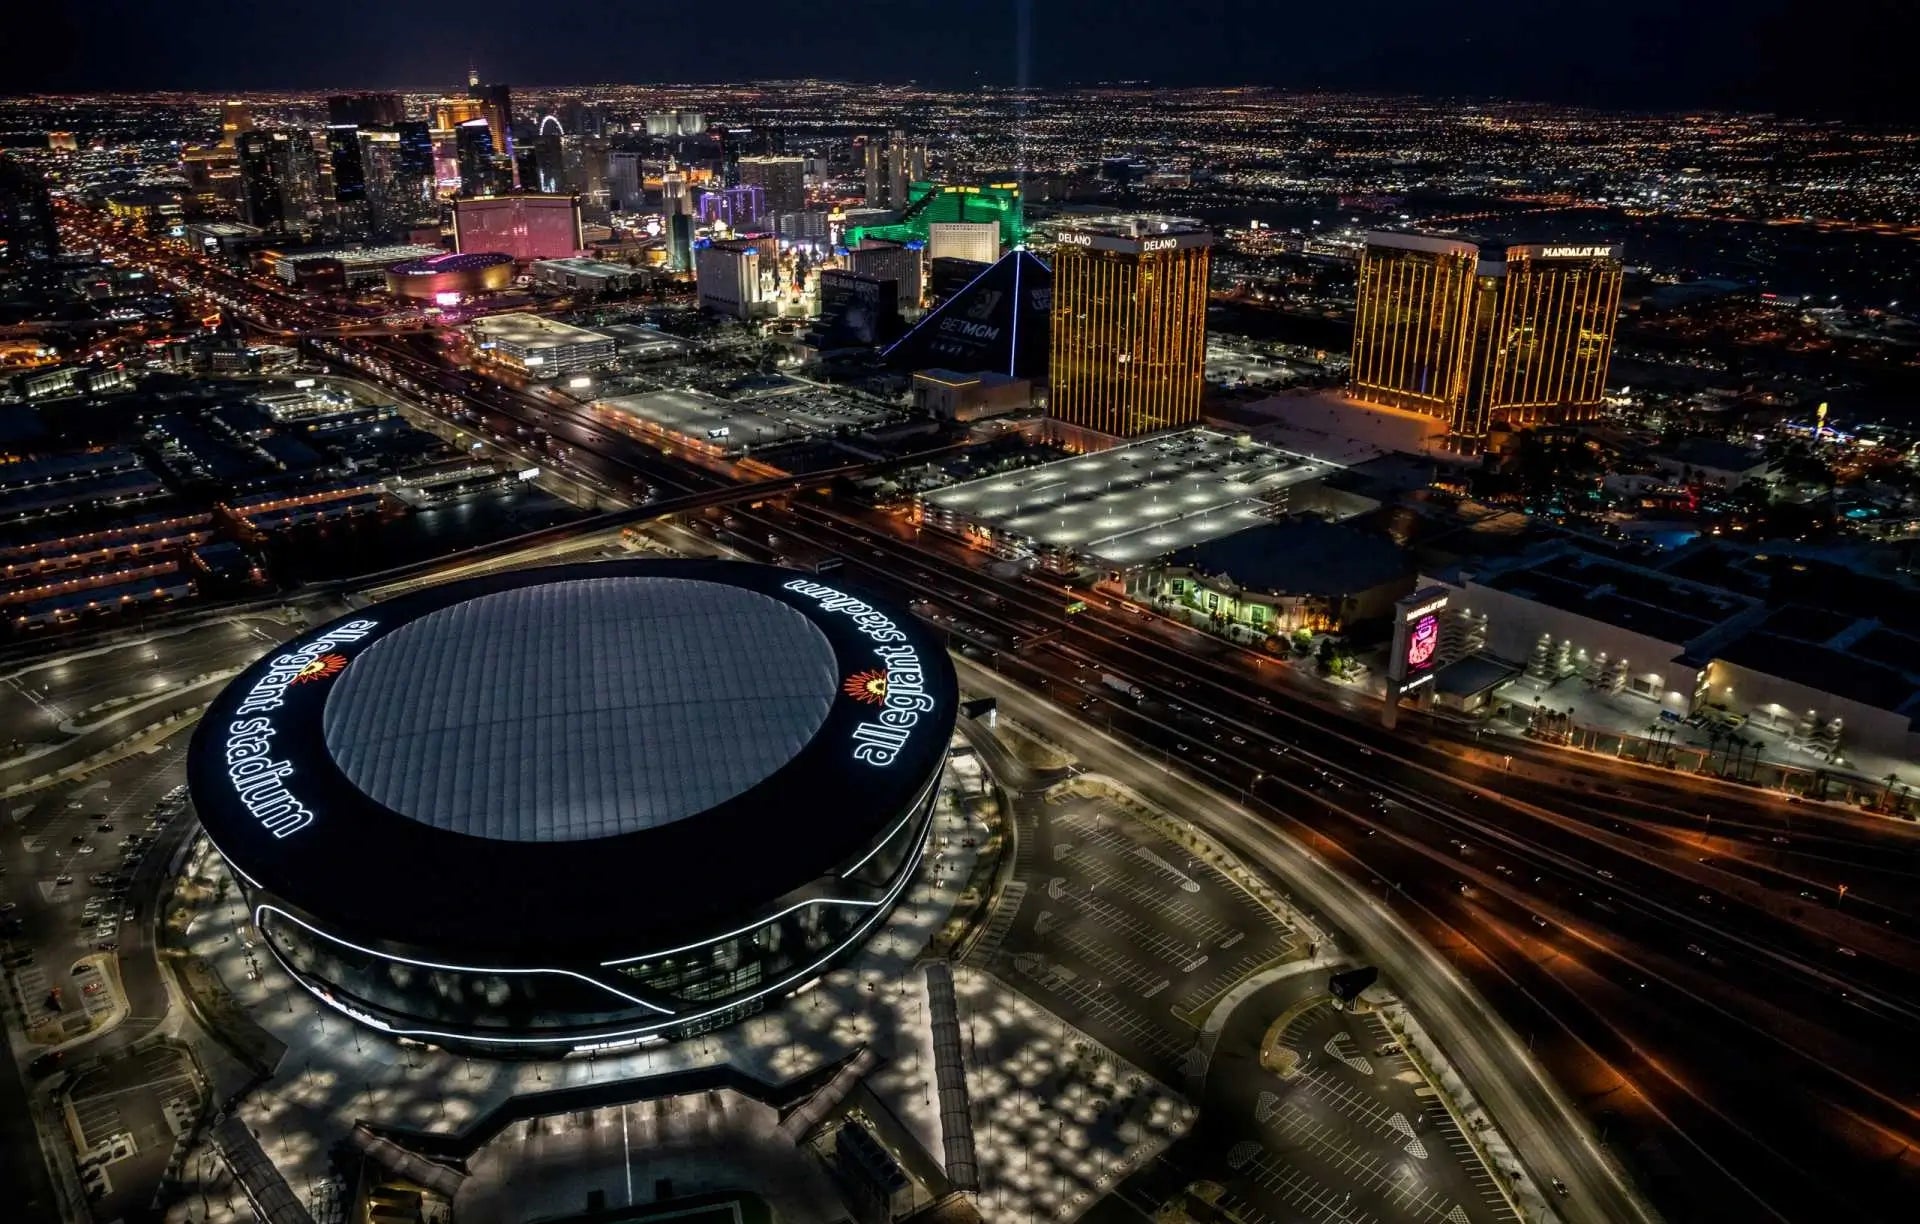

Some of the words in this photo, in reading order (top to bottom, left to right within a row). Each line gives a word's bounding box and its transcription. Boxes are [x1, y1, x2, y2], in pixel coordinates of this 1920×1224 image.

[1058, 232, 1091, 246] DELANO
[1144, 238, 1177, 251] DELANO
[1542, 247, 1593, 257] MANDALAY
[1594, 247, 1612, 257] BAY
[940, 317, 1000, 341] BETMGM
[783, 578, 907, 645] stadium
[236, 619, 378, 715] allegiant
[852, 645, 935, 768] allegiant
[226, 716, 314, 839] stadium
